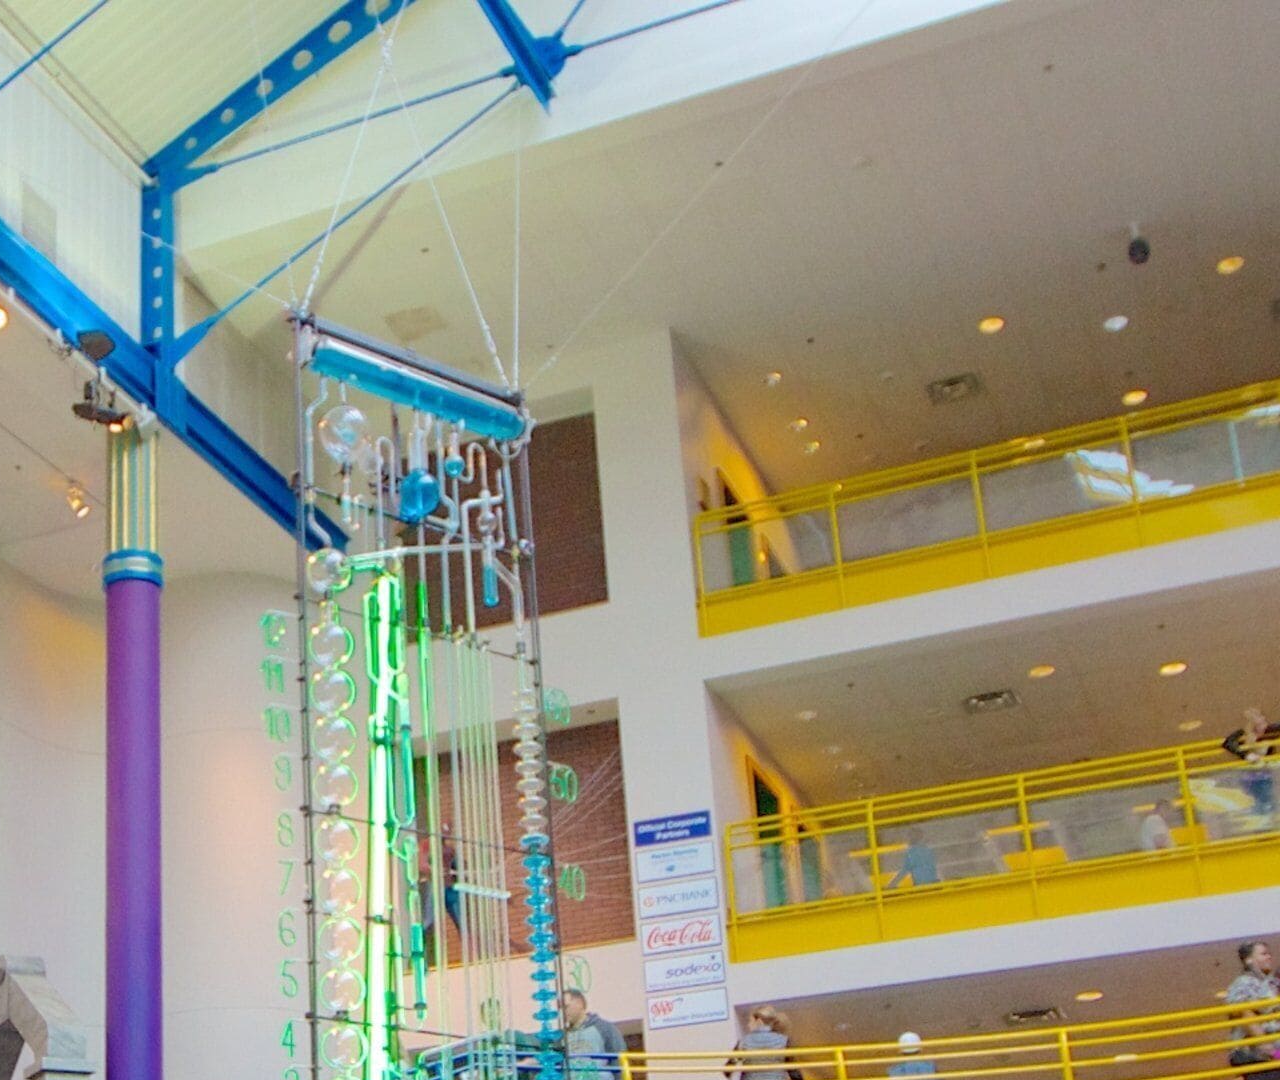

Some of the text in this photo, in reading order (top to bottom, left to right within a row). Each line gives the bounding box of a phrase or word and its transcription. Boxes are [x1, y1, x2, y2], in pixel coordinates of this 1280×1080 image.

[275, 756, 292, 791] 9
[549, 765, 578, 803] 50
[278, 813, 294, 848] 8
[667, 816, 707, 830] Corporate
[278, 860, 294, 896] 7
[278, 911, 296, 947] 6
[282, 959, 298, 998] 5
[665, 962, 721, 979] sodexo
[282, 1020, 296, 1057] 4
